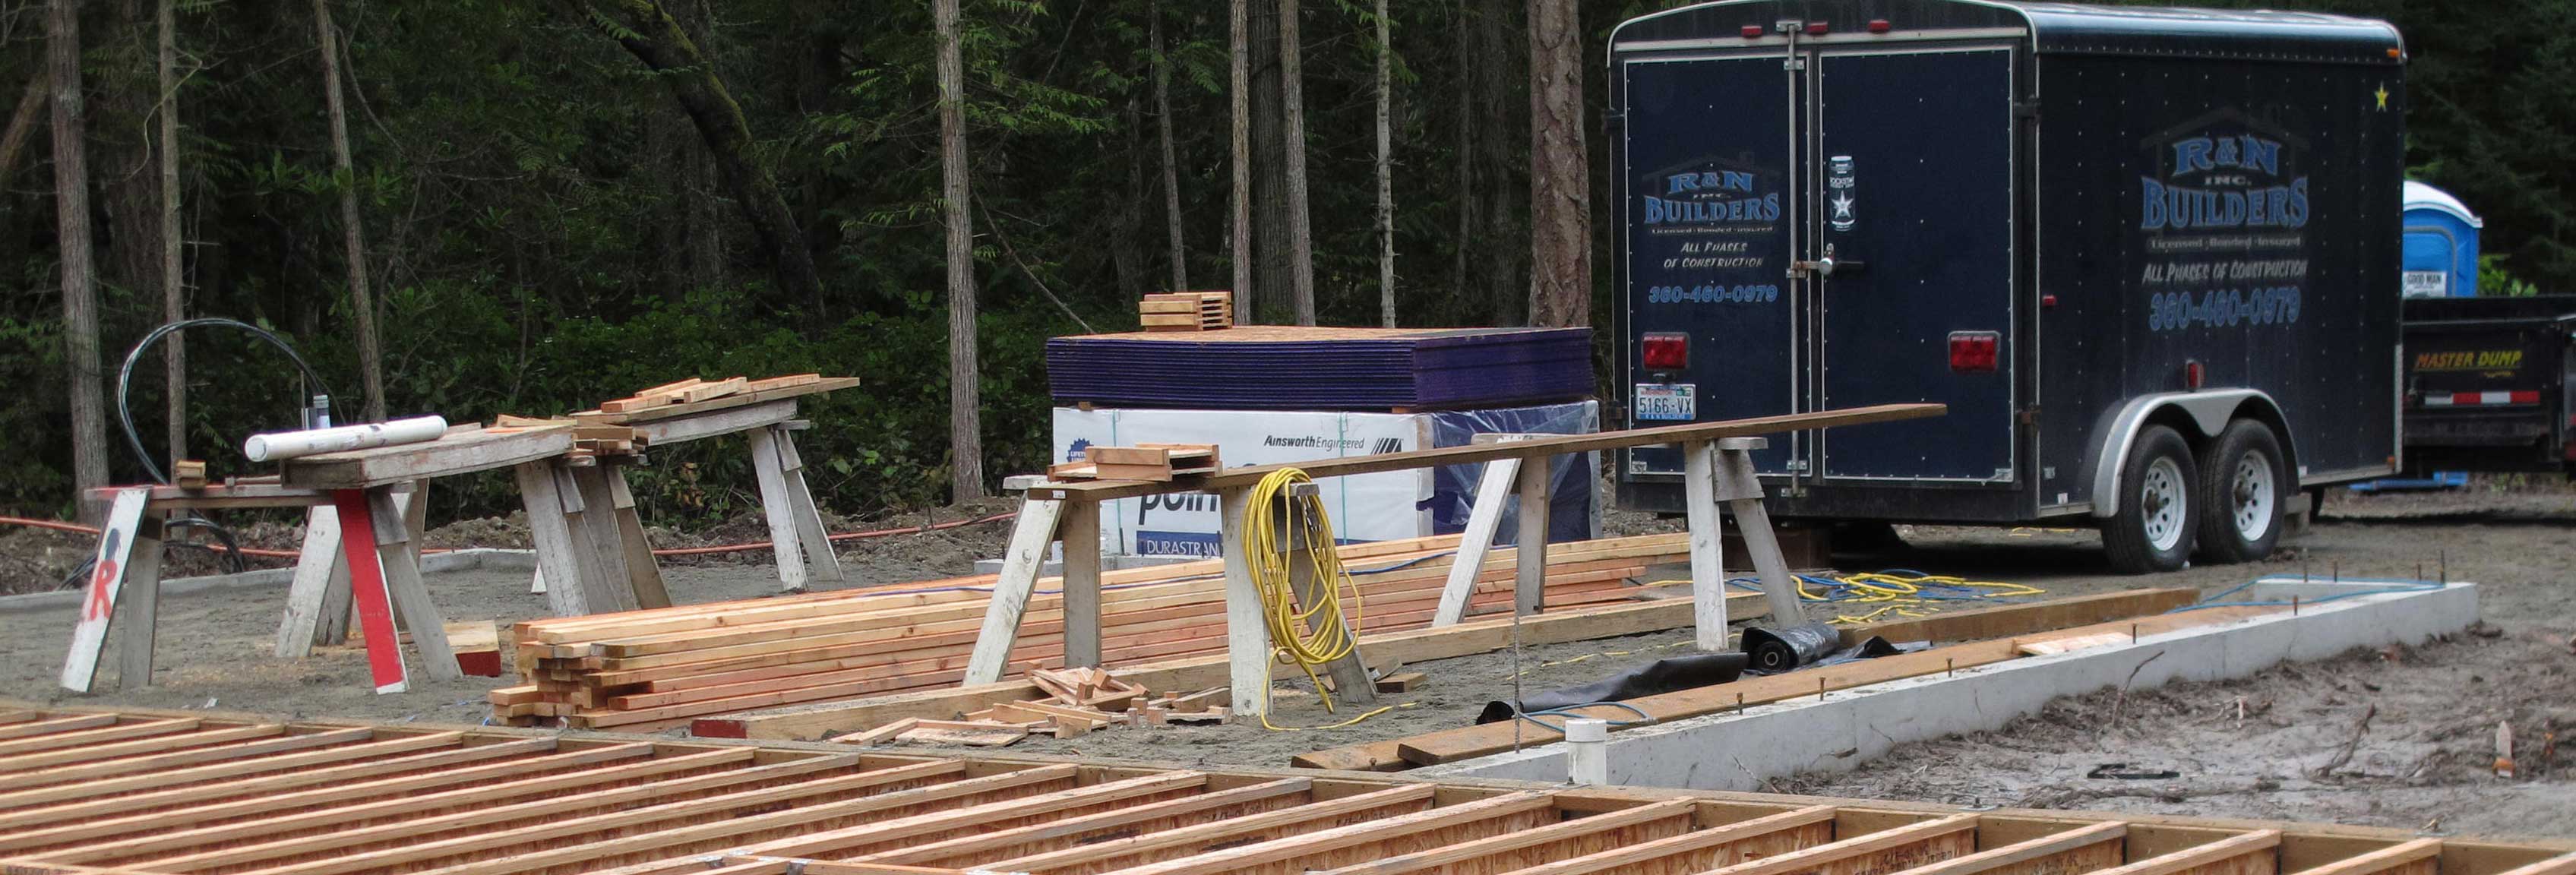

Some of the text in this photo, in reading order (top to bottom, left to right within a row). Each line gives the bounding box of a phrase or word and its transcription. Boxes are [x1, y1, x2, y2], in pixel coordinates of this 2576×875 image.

[2171, 134, 2282, 177] R&N
[1667, 170, 1755, 195] R&N
[1643, 192, 1781, 225] BUILDERS
[2140, 175, 2310, 230] BUILDERS
[1680, 242, 1700, 253] ALL
[1682, 257, 1765, 268] CONSTRUCTION
[2141, 259, 2309, 284] ALL PHASES OF CONSTRUCTION
[1648, 285, 1778, 304] 360-460-0979
[2148, 285, 2302, 332] 360-460-0979
[2415, 350, 2523, 368] MASTER DUMP
[1138, 492, 1218, 526] poin
